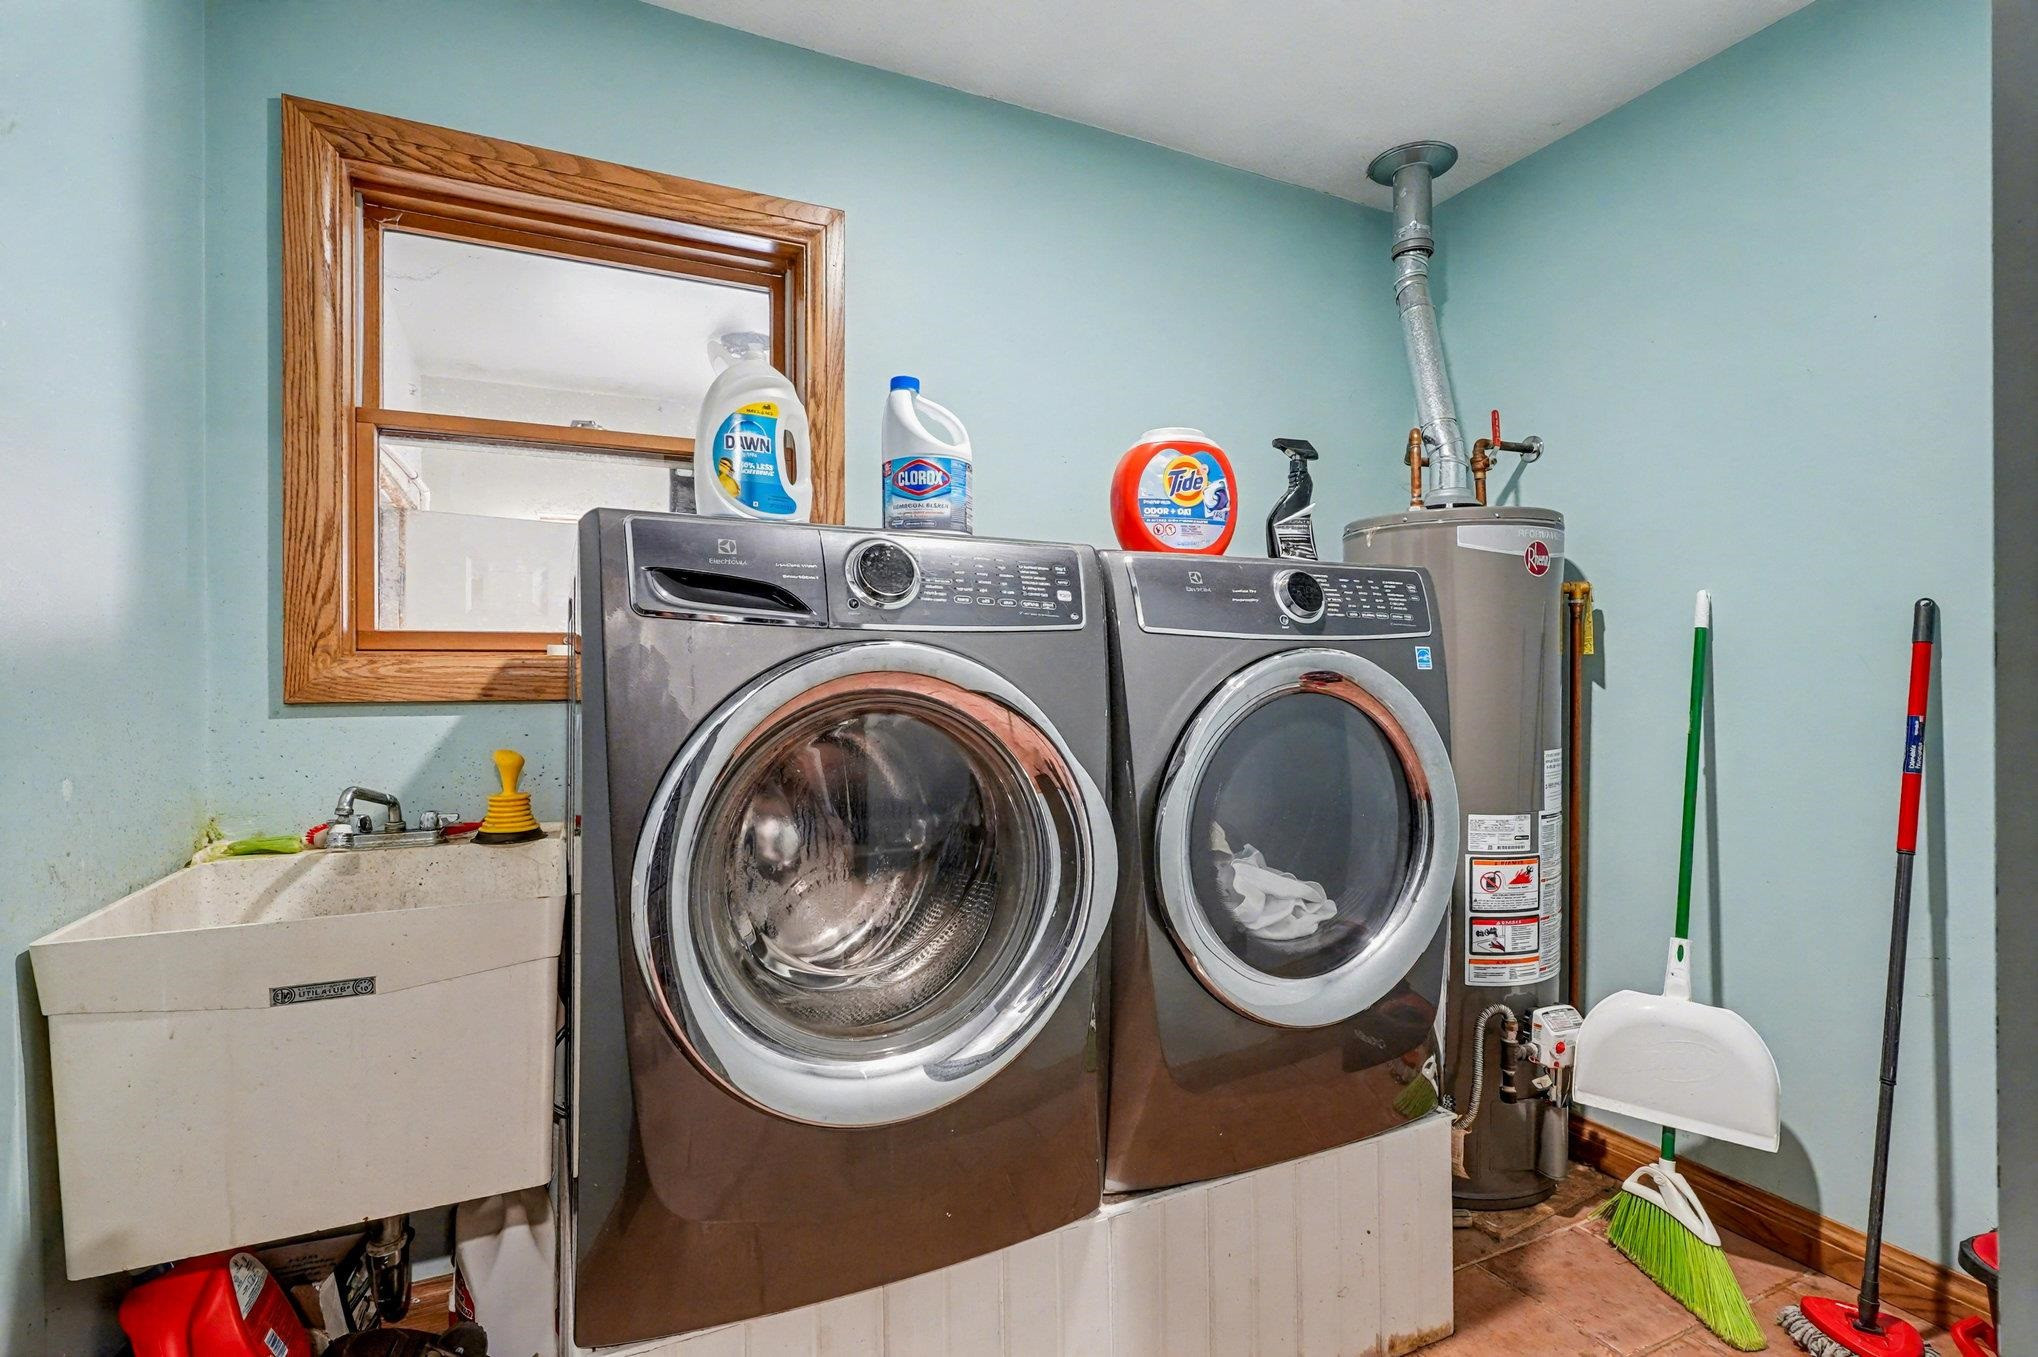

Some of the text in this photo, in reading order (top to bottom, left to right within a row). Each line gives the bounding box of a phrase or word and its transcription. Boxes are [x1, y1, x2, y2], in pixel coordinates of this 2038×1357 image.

[725, 434, 770, 453] DAWN
[898, 470, 943, 487] CLOROX
[1168, 469, 1204, 497] Tide
[1144, 507, 1169, 515] ODOR
